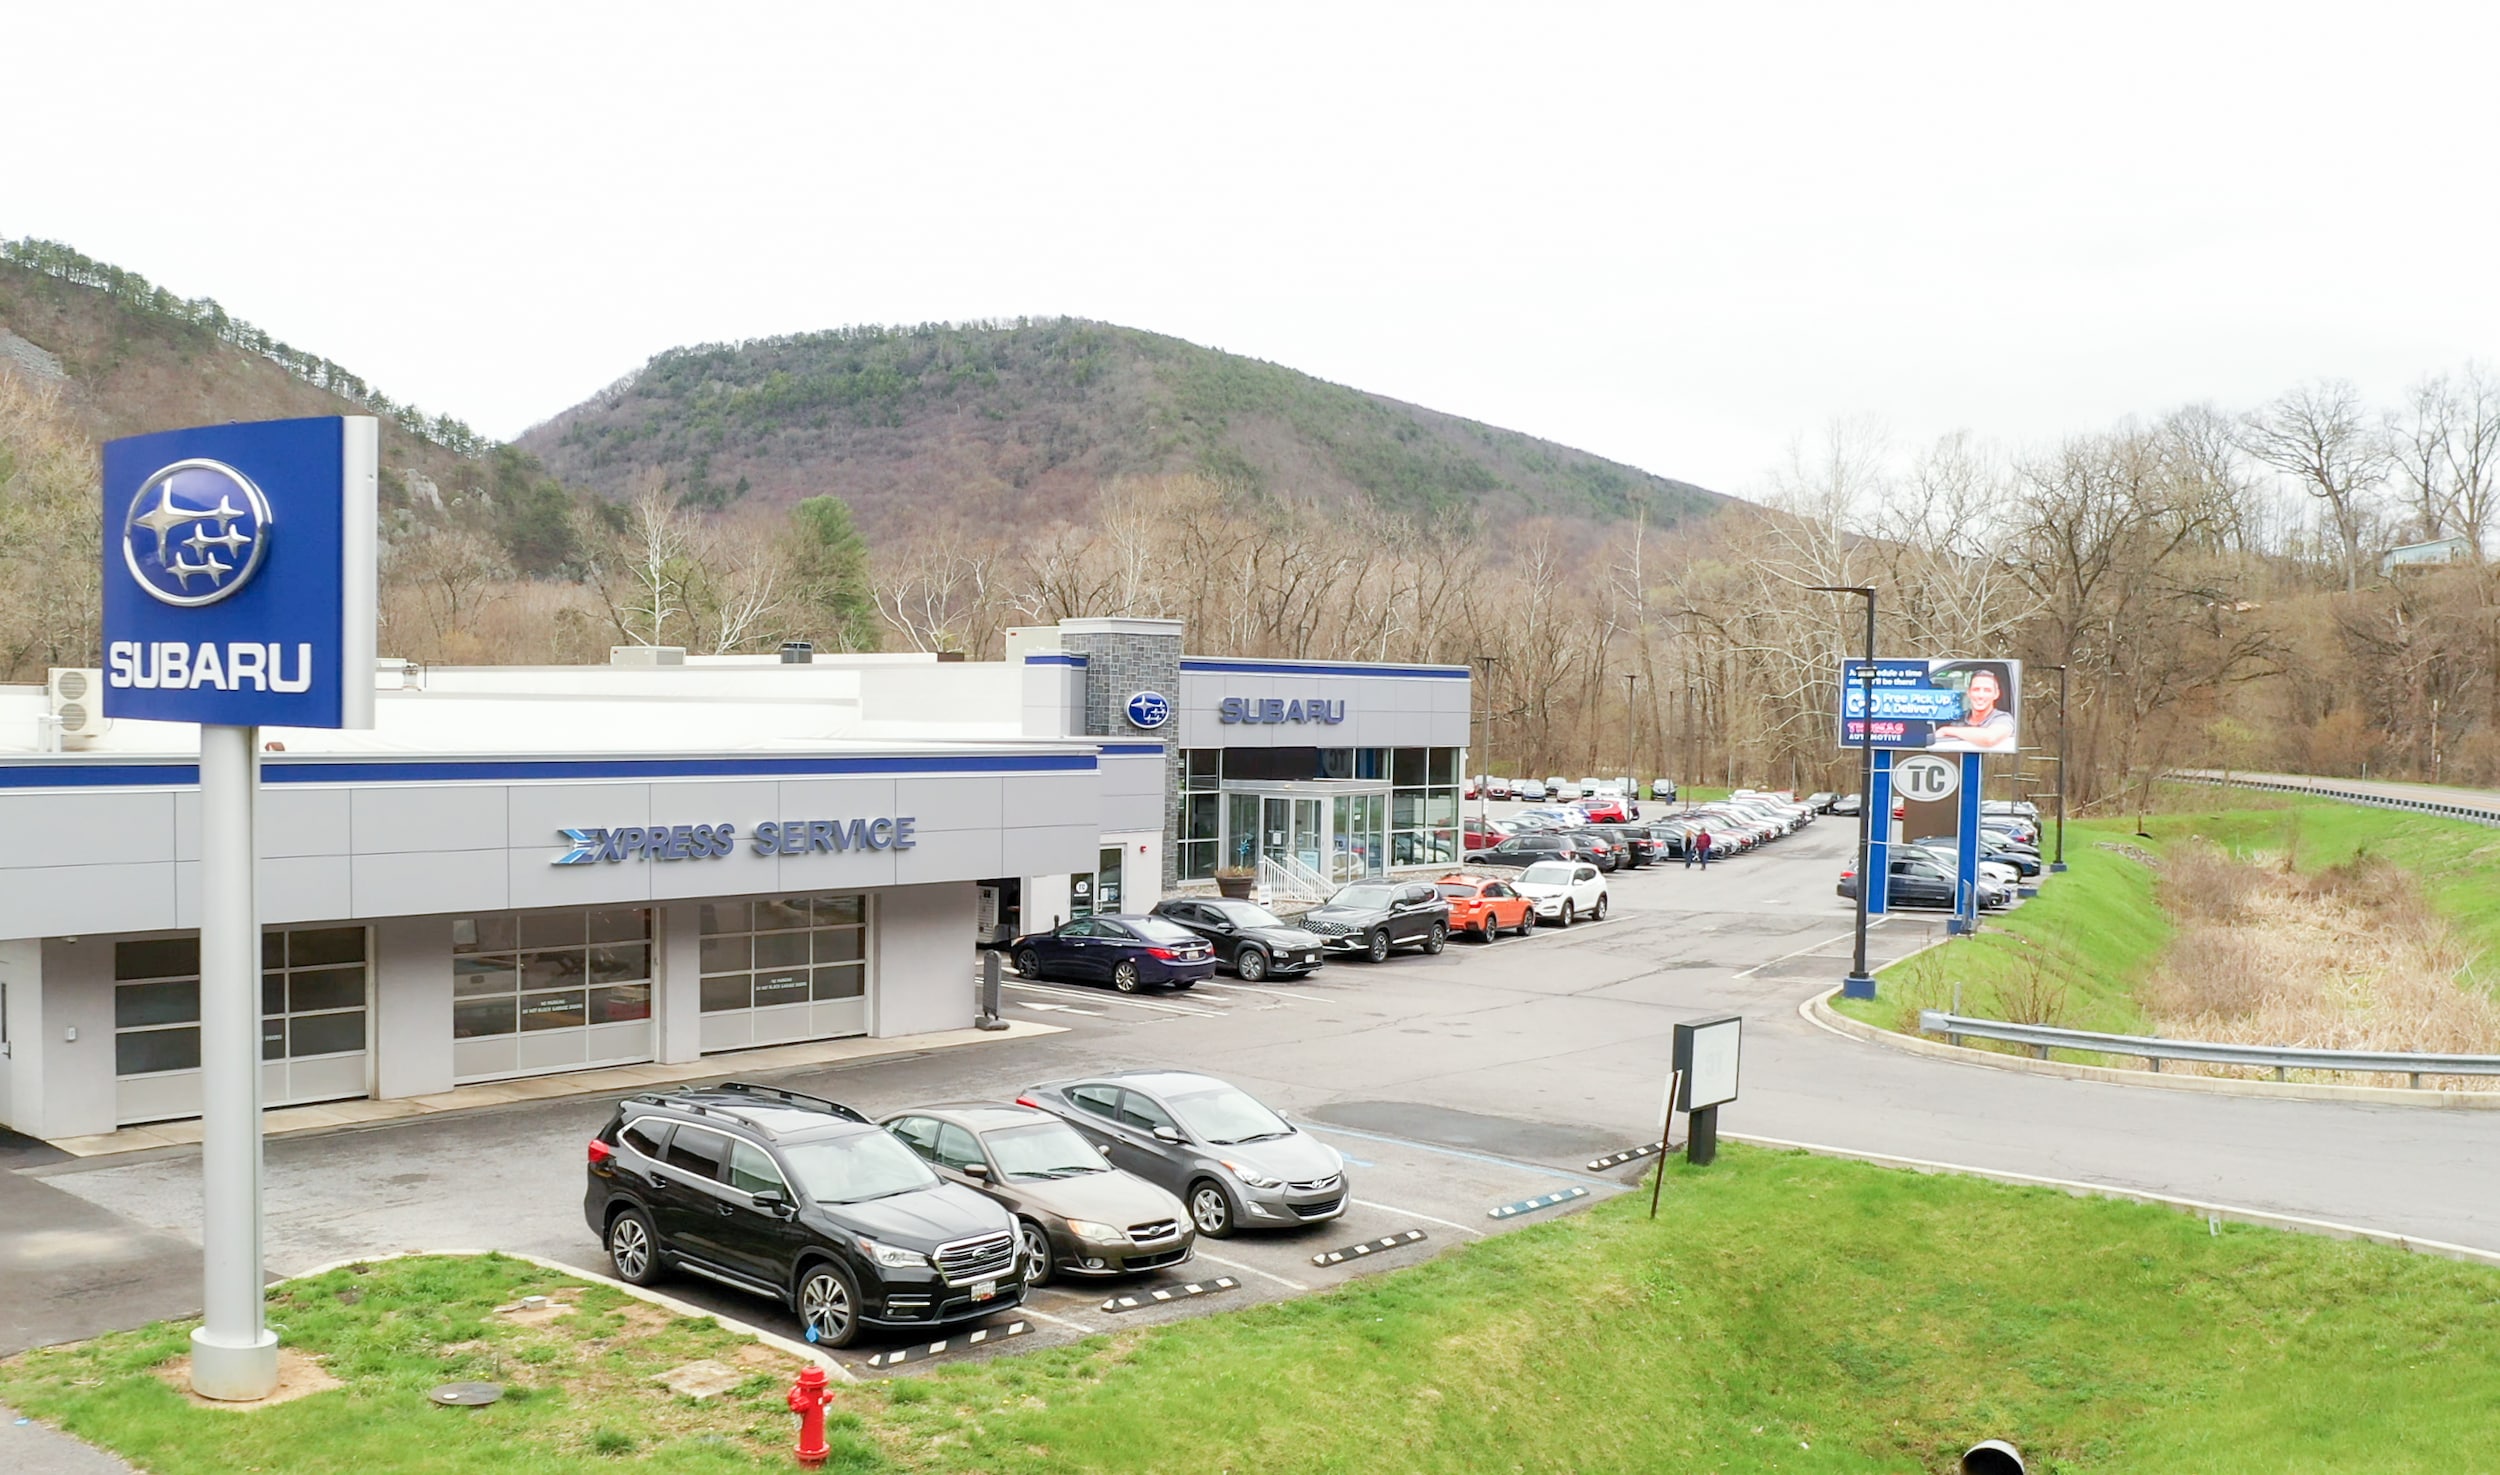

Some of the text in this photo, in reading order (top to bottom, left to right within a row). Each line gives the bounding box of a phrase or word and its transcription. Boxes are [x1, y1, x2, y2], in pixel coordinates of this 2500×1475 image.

[109, 641, 312, 694] SUBARU
[1219, 697, 1345, 725] SUBARU
[1883, 693, 1908, 703] Free
[1911, 694, 1934, 704] Pick
[1883, 703, 1938, 715] & Delivery
[1907, 765, 1945, 792] TC
[551, 816, 918, 866] EXPRESS SERVICE
